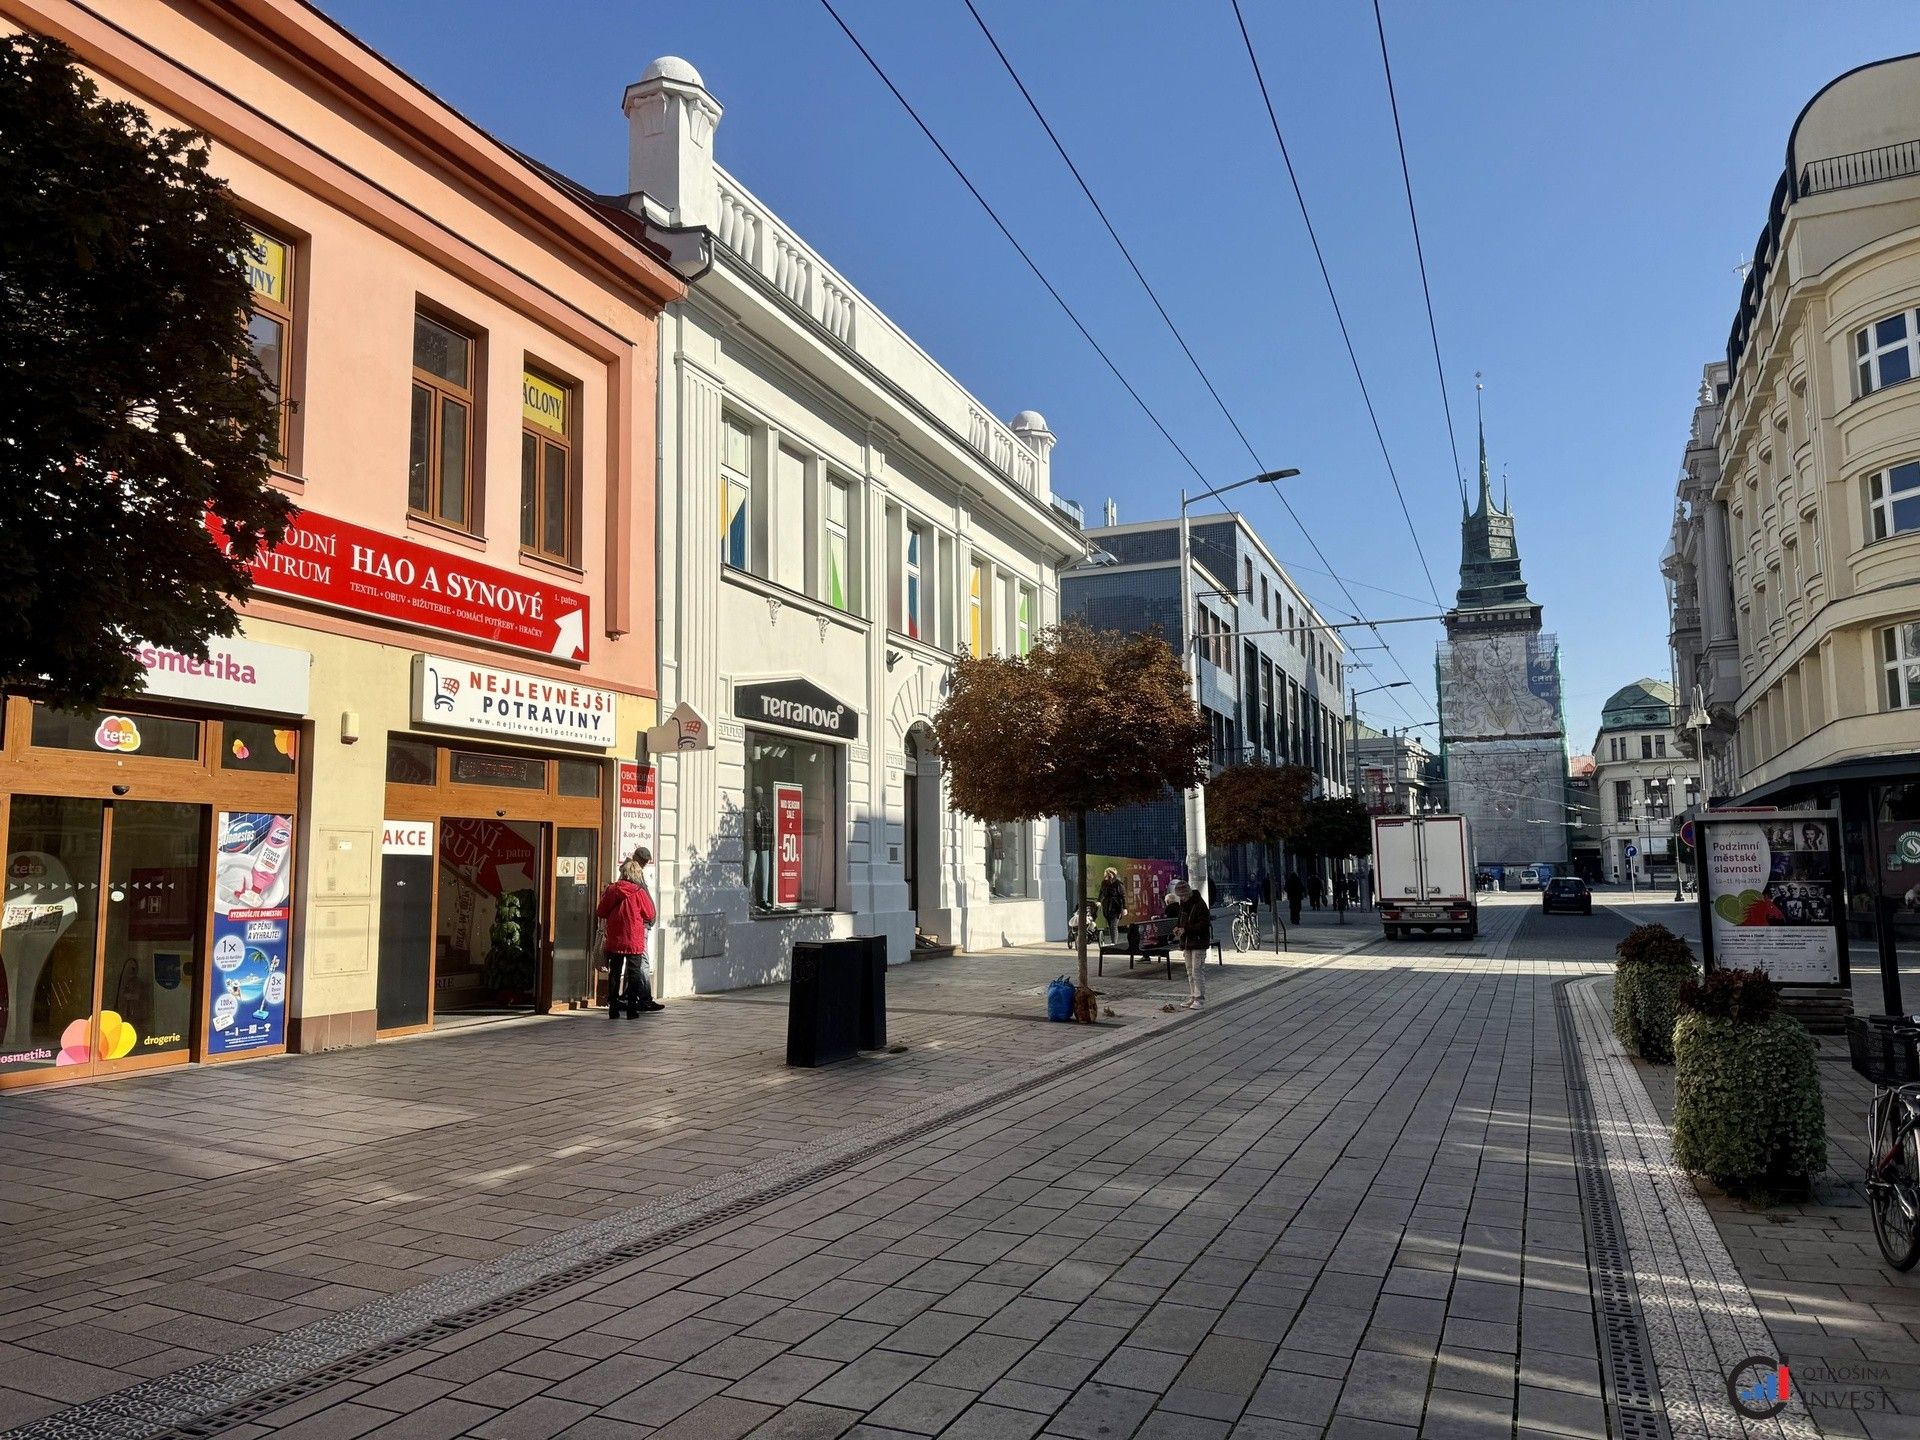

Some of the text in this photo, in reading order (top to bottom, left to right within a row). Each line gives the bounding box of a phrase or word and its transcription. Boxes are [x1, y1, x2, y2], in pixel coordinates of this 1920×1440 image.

[350, 544, 544, 621] HAO A SYNOVÉ
[561, 595, 578, 607] patro
[350, 581, 544, 637] TEXTIL OBUV BIŽUTERIE DOMÁCÍ POTŘEBY HRAČKY
[469, 671, 612, 713] NEJLEVNĚJŠÍ
[482, 696, 601, 730] POTRAVINY
[104, 729, 134, 744] teta
[469, 716, 612, 743] www.nejlevnejsipotraviny.eu
[623, 810, 652, 819] OTEVŘENO
[382, 830, 426, 846] AKCE
[1713, 841, 1760, 851] Podzimní
[262, 852, 278, 864] FOAM
[506, 847, 531, 860] patro
[1713, 853, 1757, 862] městské
[12, 858, 44, 875] teta
[1714, 864, 1762, 873] slavnosti
[143, 1032, 181, 1046] drogerie
